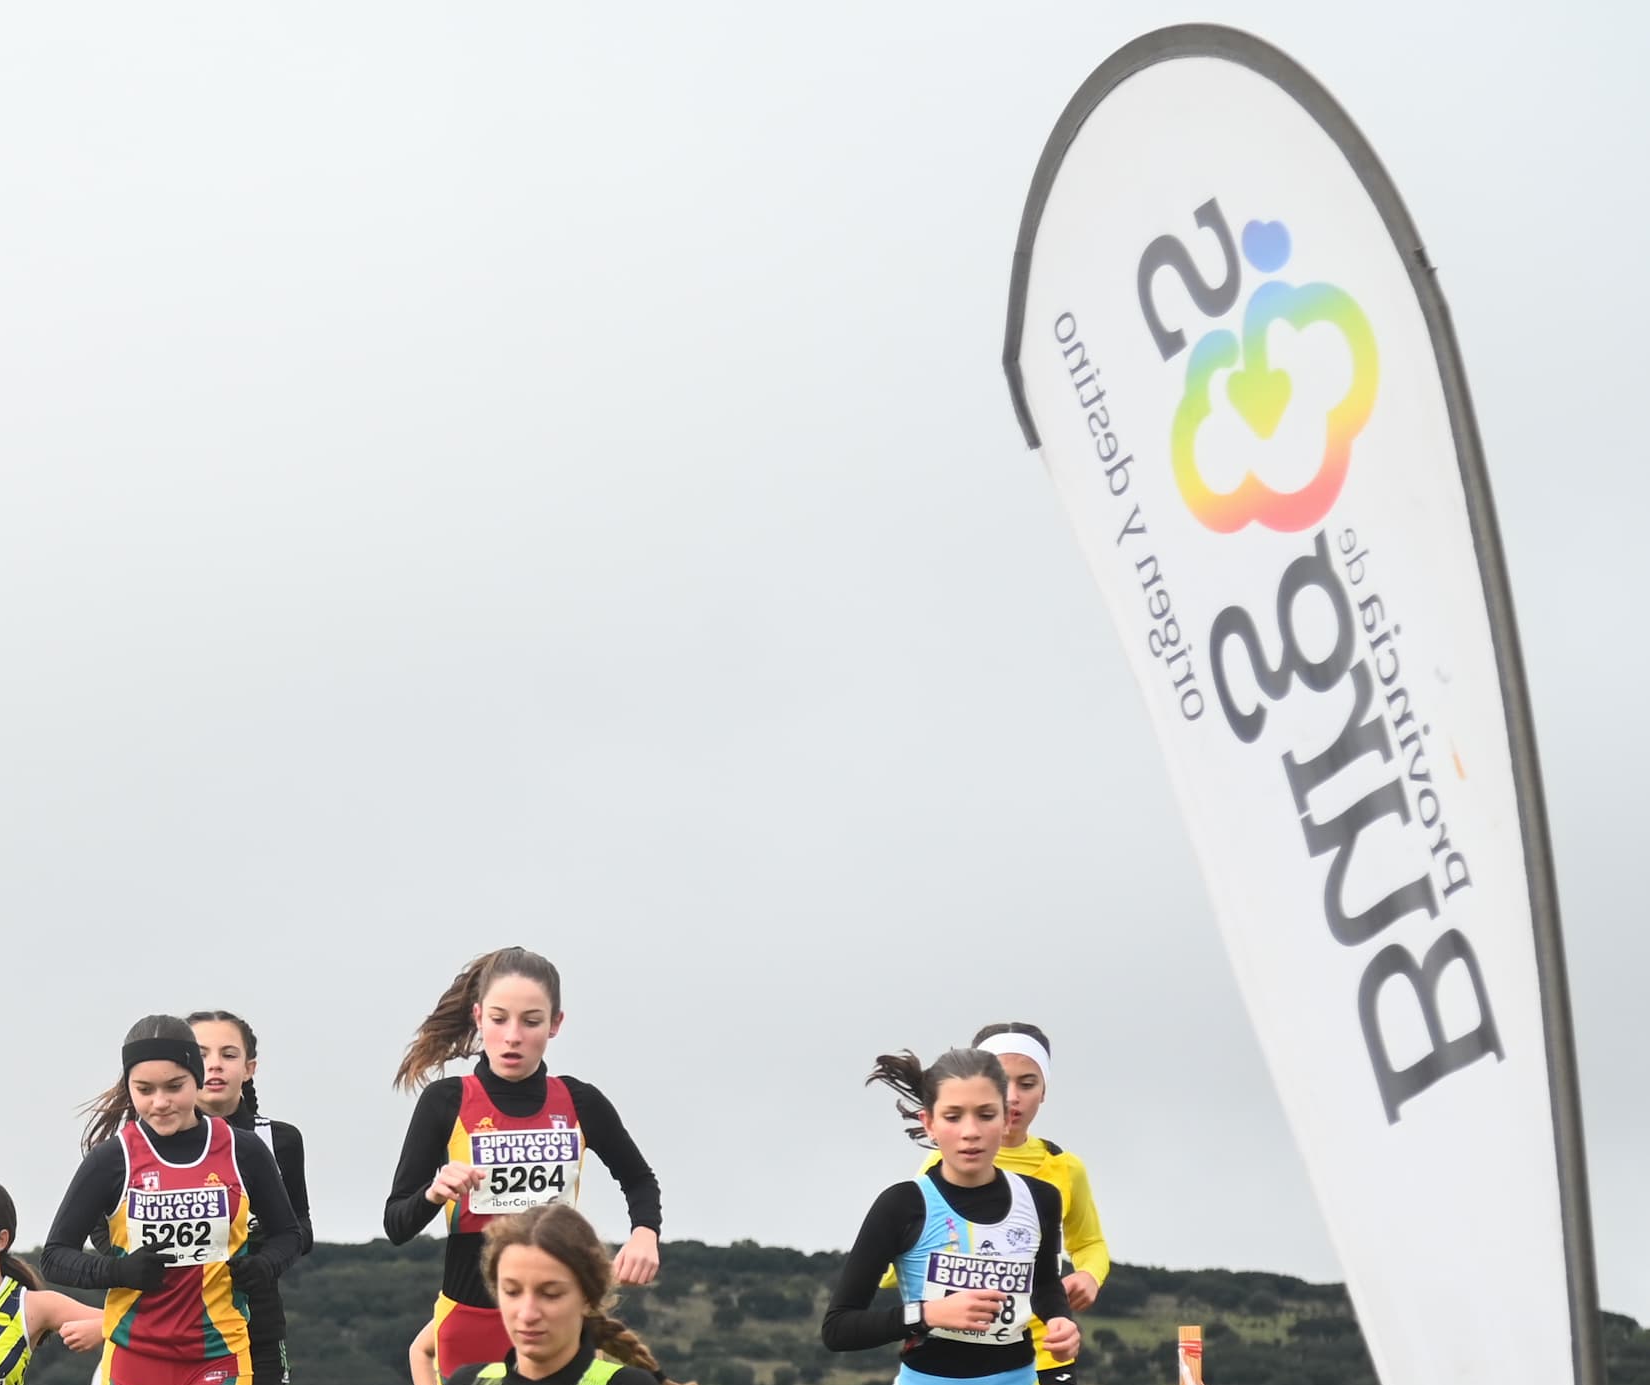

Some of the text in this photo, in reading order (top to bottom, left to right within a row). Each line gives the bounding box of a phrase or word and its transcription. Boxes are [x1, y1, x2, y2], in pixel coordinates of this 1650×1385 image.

[480, 1145, 573, 1163] BURGOS
[490, 1164, 566, 1195] 5264
[135, 1190, 219, 1206] DIPUTACIÓN
[134, 1203, 220, 1220] BURGOS
[141, 1221, 212, 1248] 5262
[935, 1267, 1027, 1292] BURGOS
